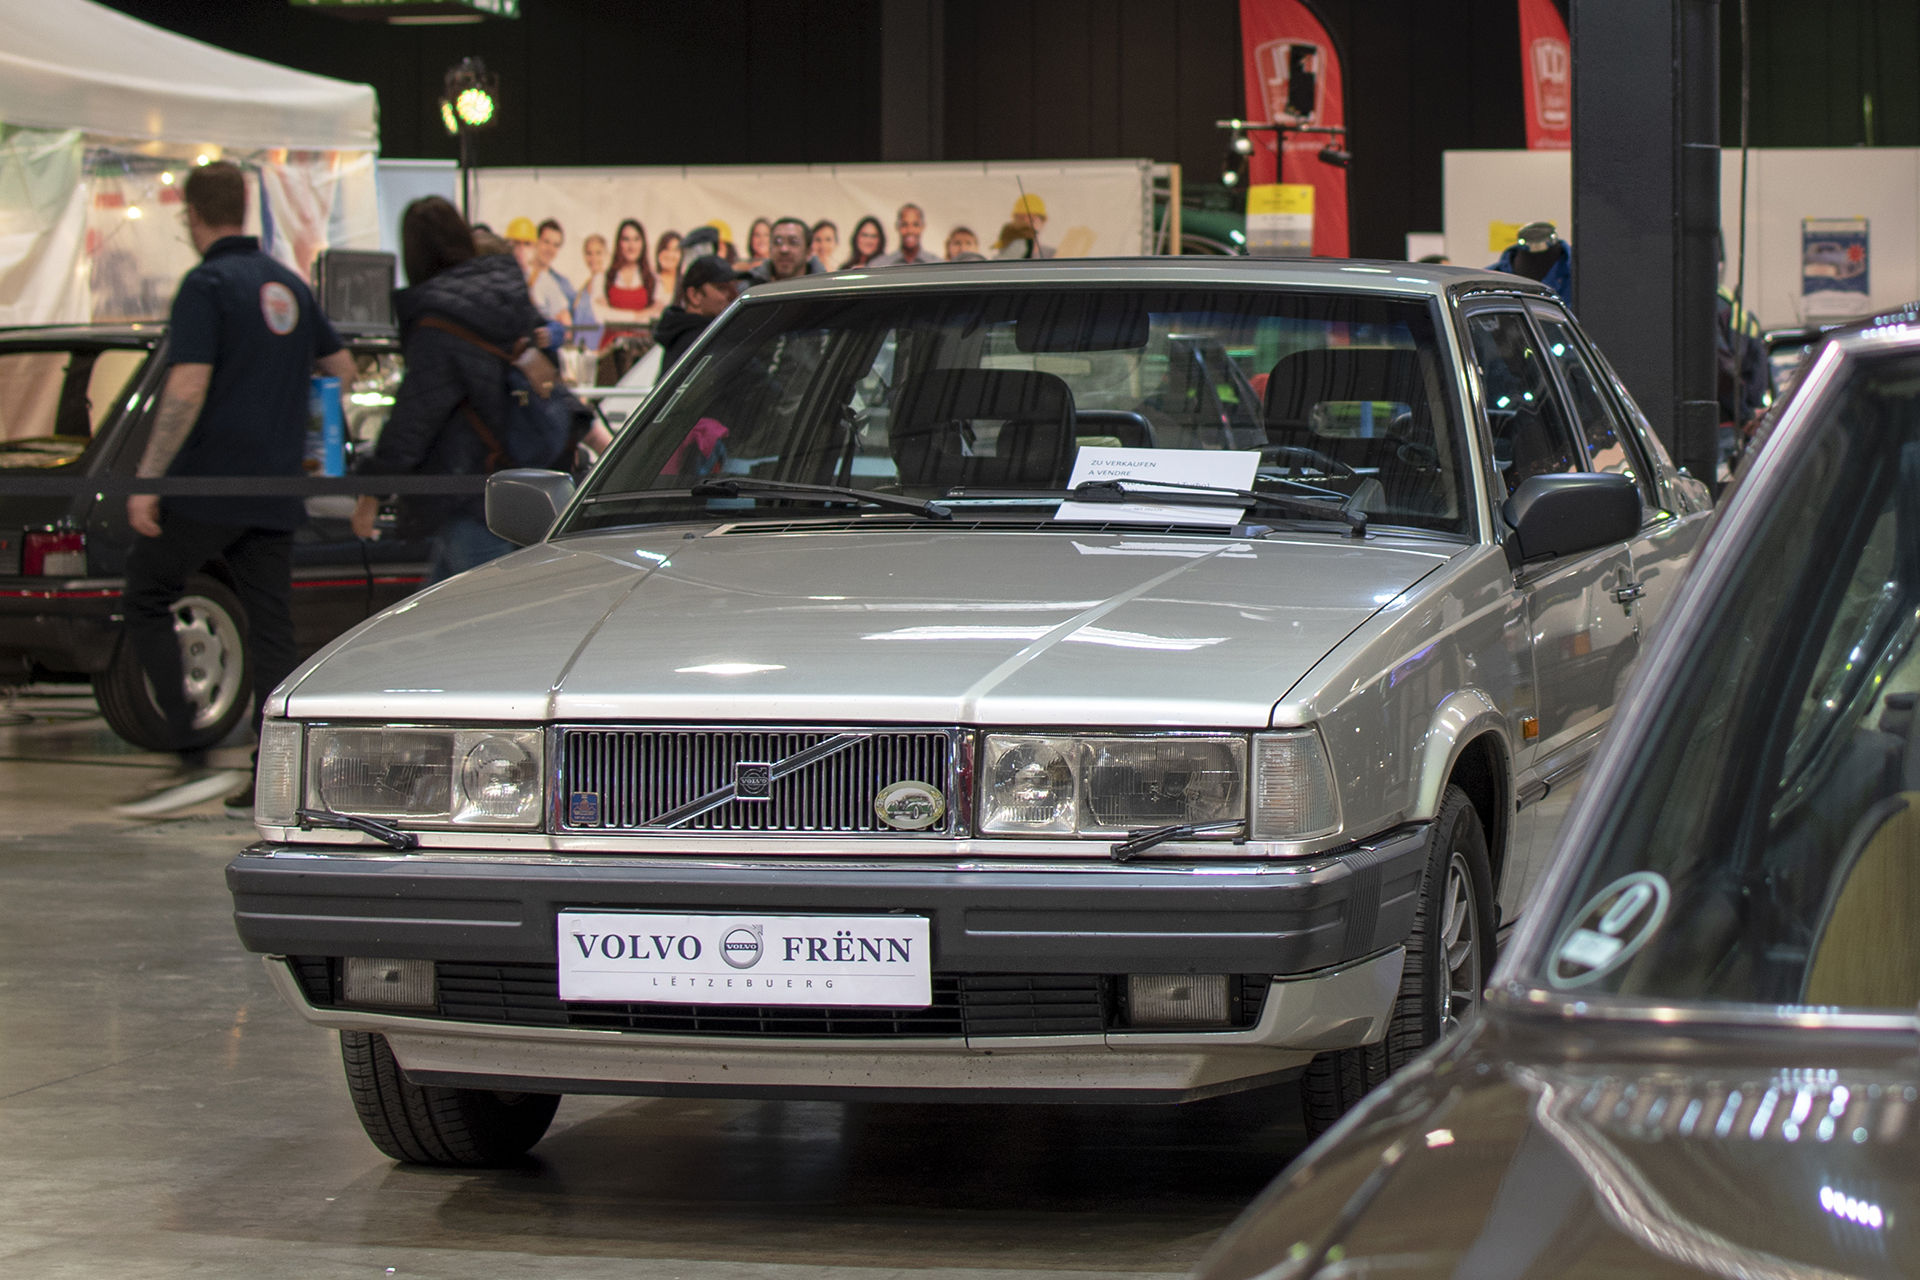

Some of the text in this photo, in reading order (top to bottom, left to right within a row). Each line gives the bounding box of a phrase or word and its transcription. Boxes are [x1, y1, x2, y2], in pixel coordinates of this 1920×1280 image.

[1105, 460, 1157, 468] VERKAUFEN
[1096, 469, 1132, 477] VENDRE
[573, 930, 913, 963] VOLVO FRËNN
[652, 975, 834, 989] LËTZEBUERG
